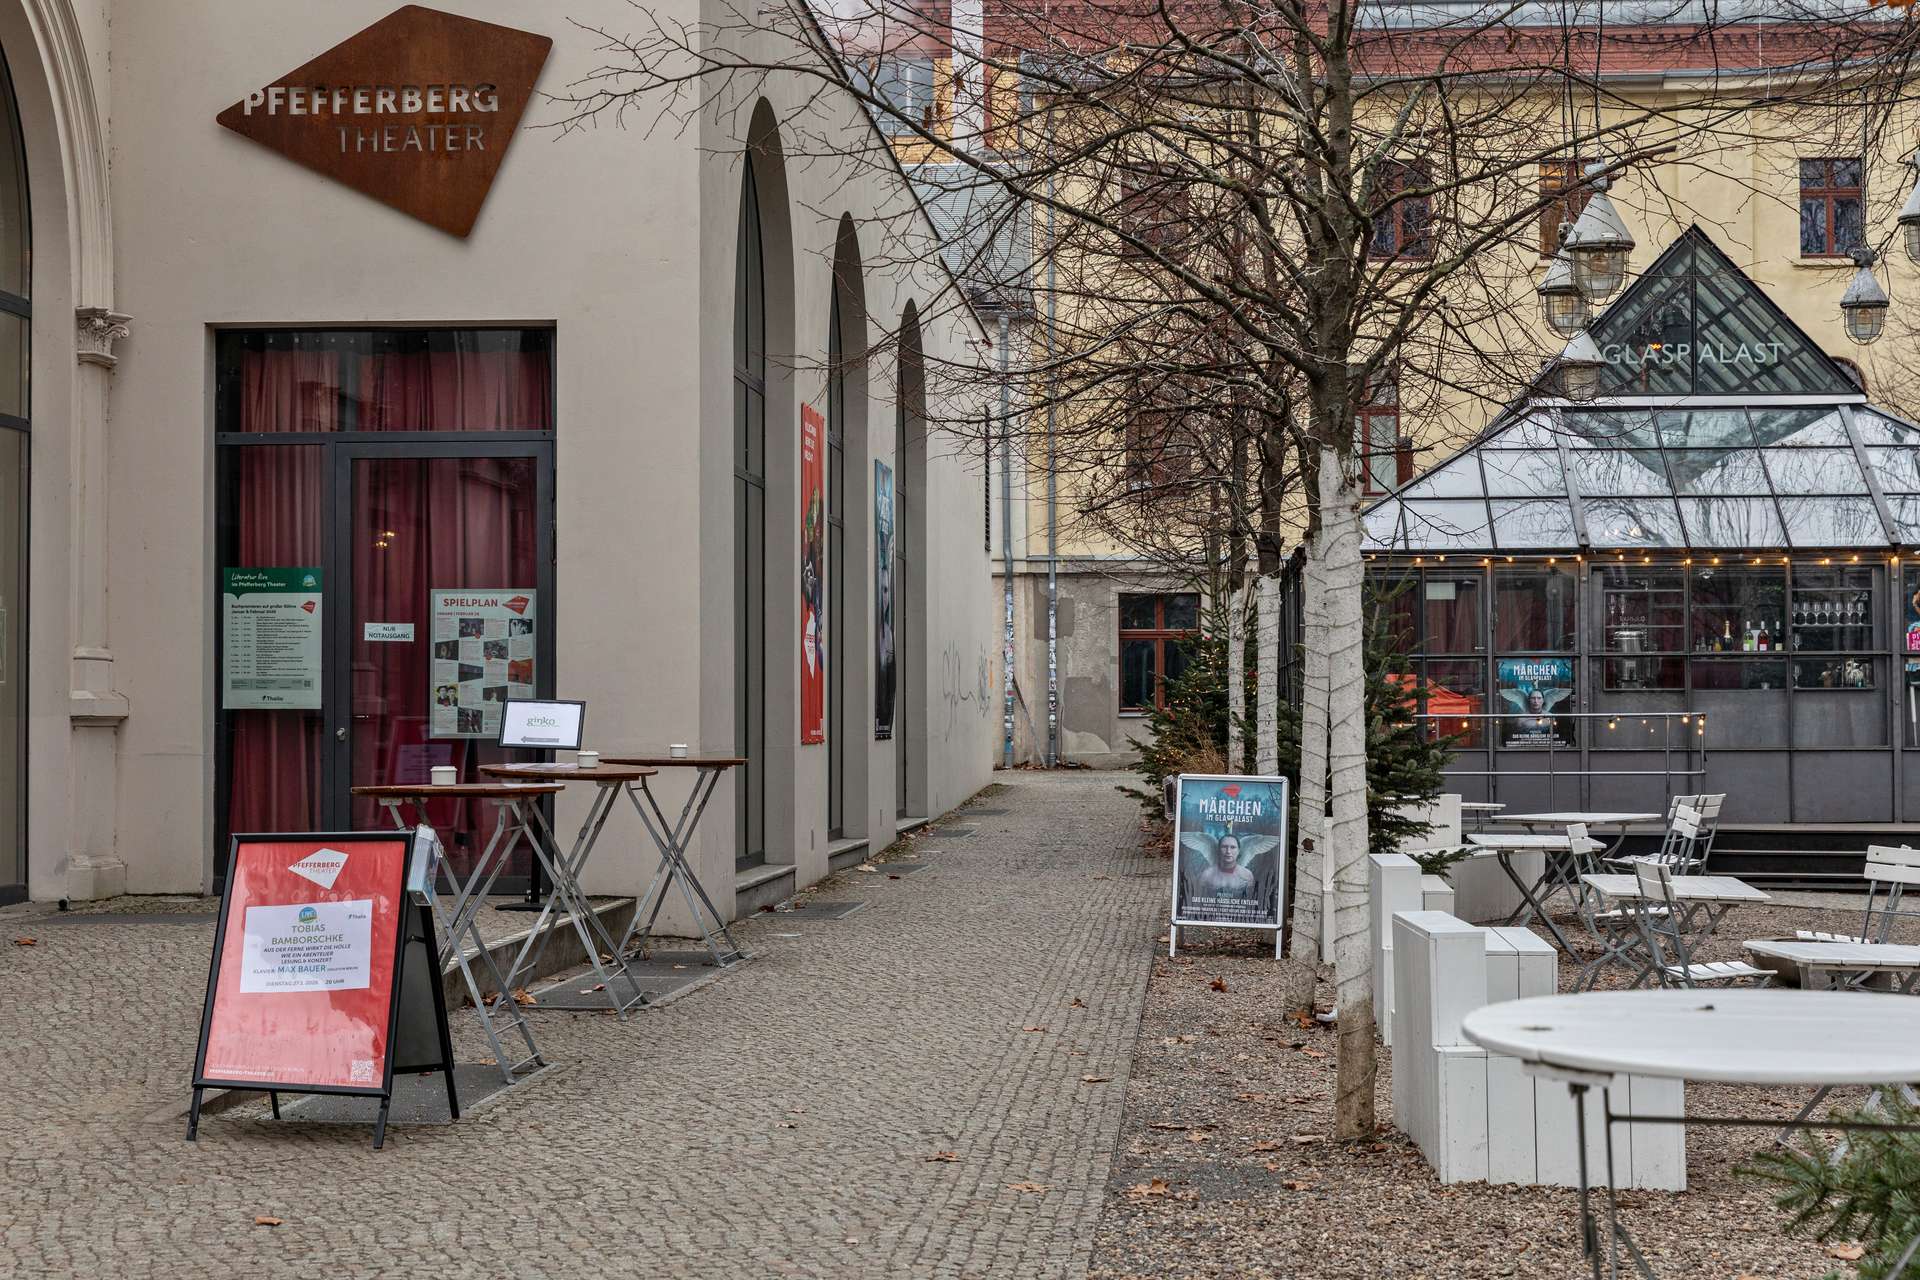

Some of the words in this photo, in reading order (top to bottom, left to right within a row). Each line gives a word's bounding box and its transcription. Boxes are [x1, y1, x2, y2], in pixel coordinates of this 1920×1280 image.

[243, 83, 499, 116] PFEFFERBERG
[336, 124, 485, 153] THEATER
[1603, 342, 1784, 365] GLASPALAST
[443, 598, 498, 608] SPIELPLAN
[1513, 664, 1557, 676] MÄRCHEN
[526, 716, 555, 726] ginko
[1199, 797, 1262, 816] MÄRCHEN
[292, 924, 326, 933] TOBIAS
[271, 934, 344, 945] BAMBORSCHKE
